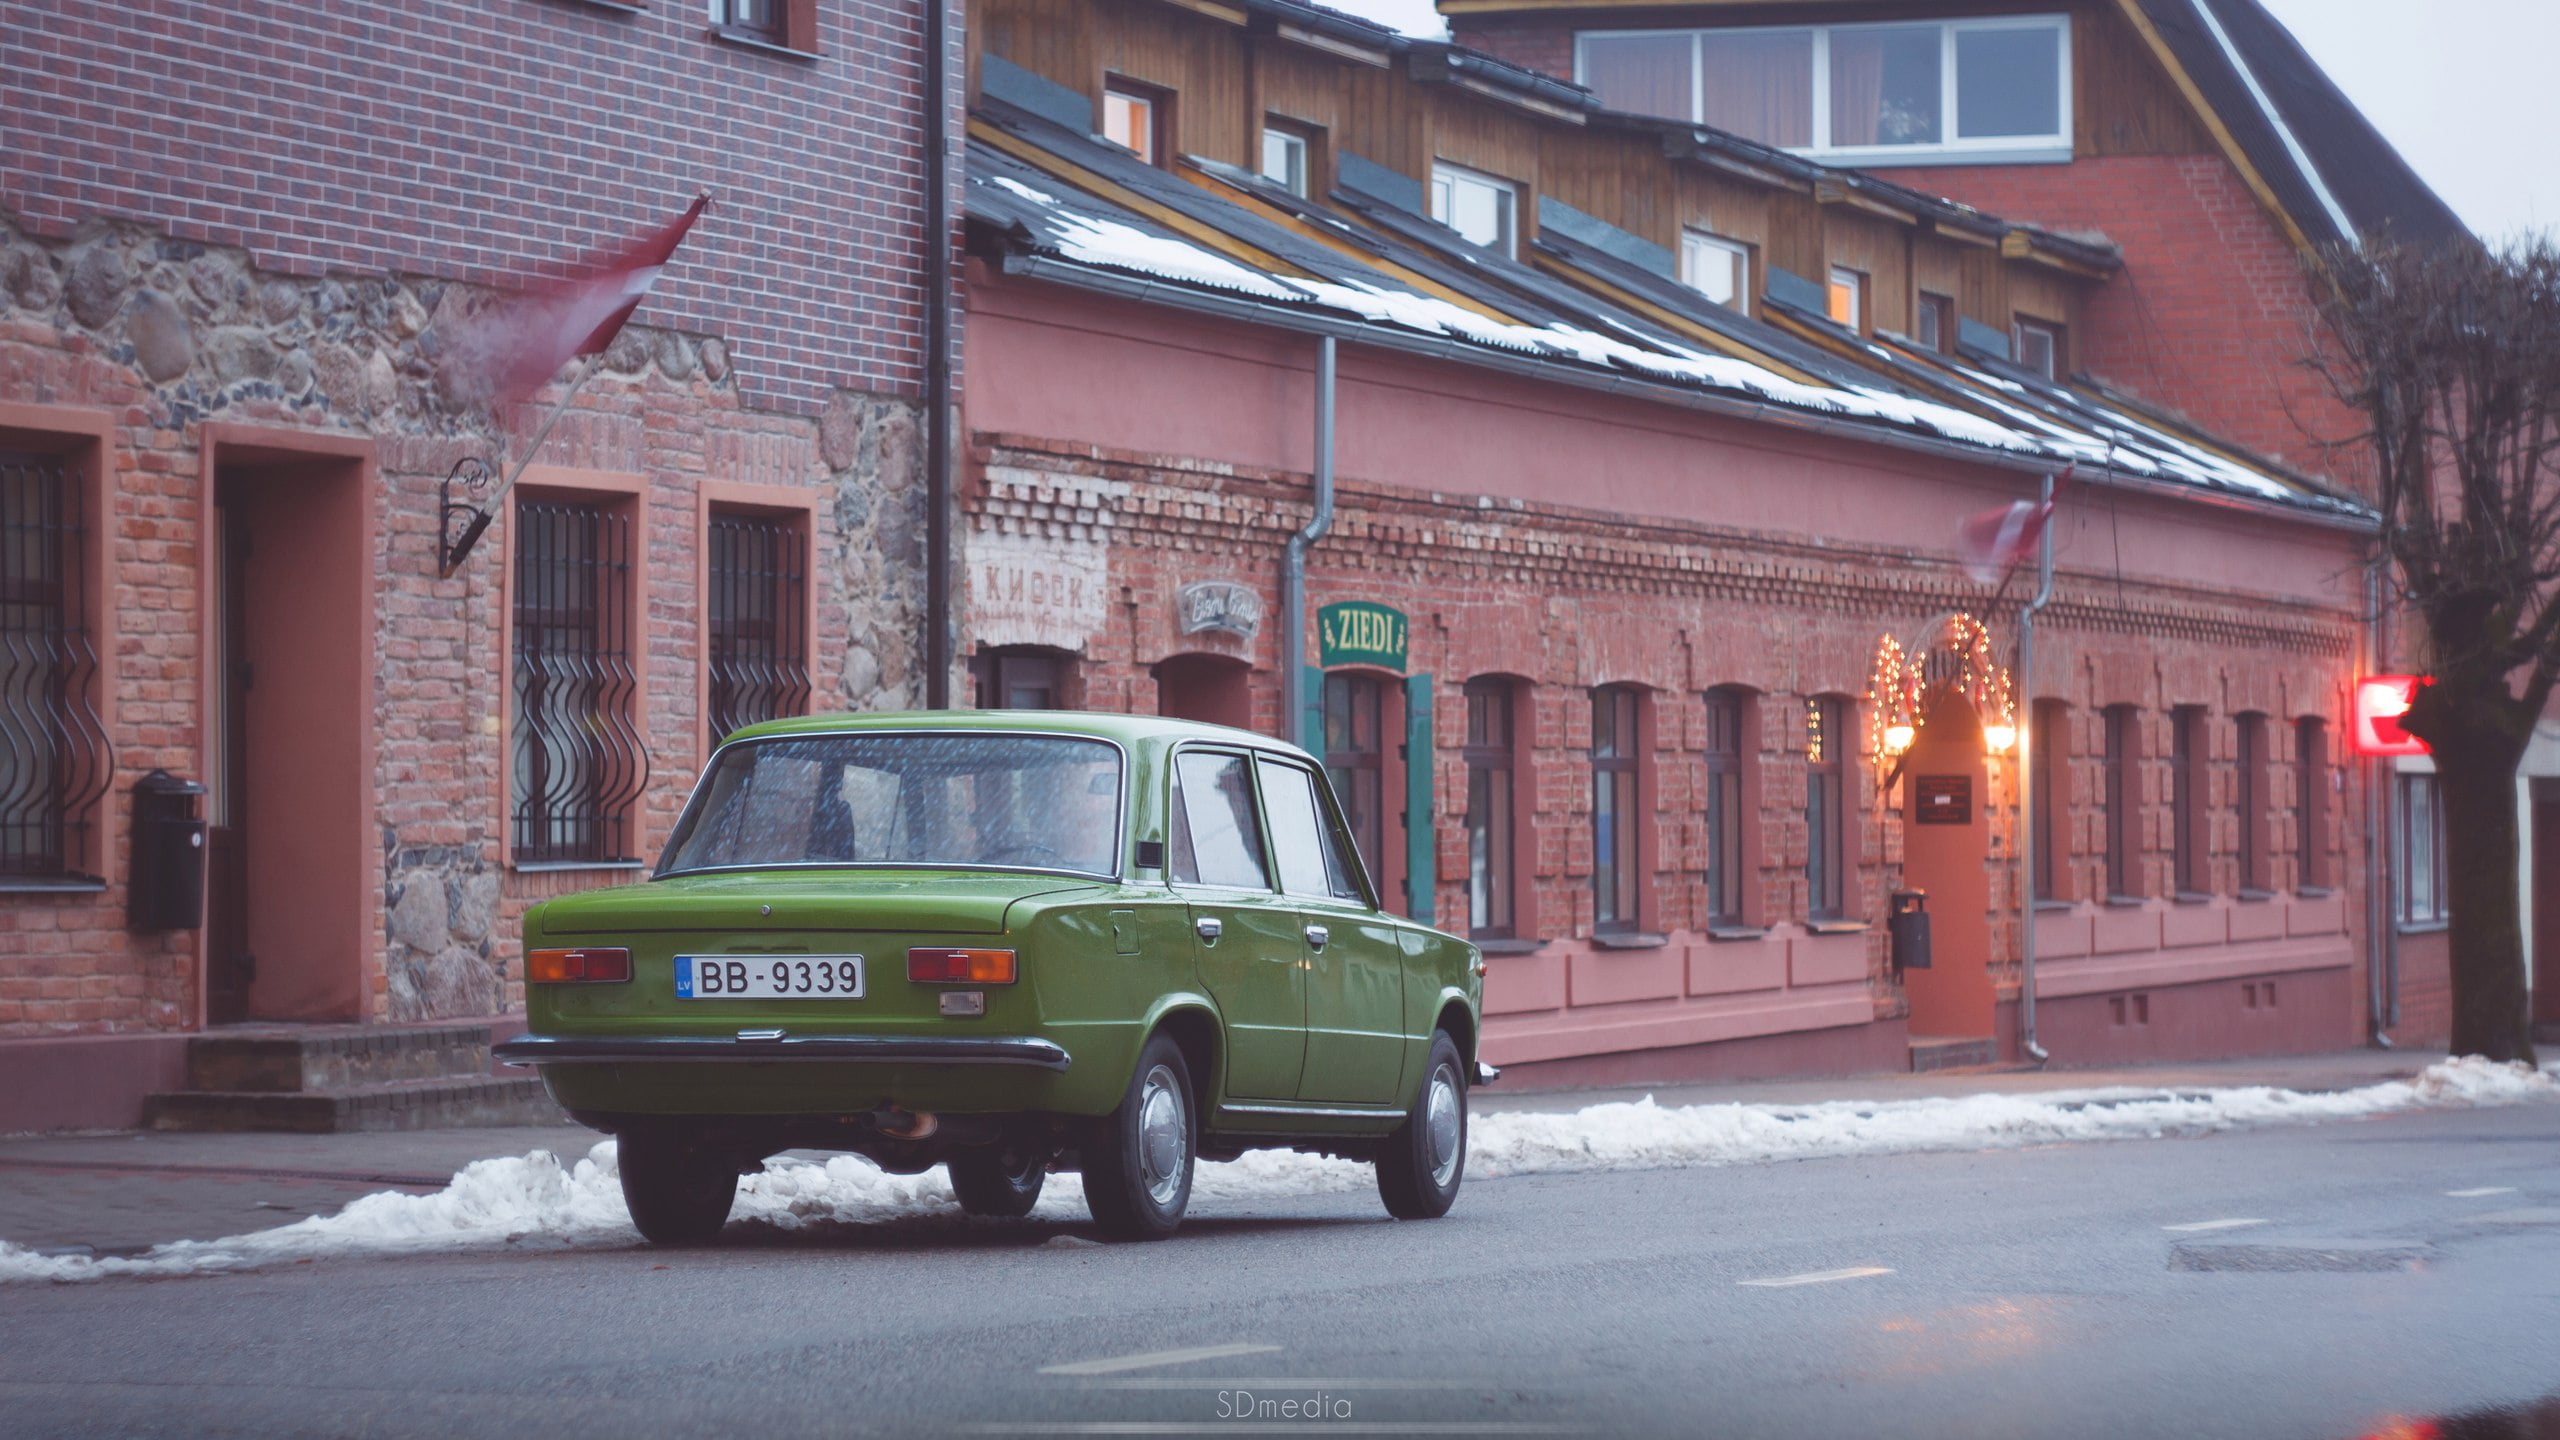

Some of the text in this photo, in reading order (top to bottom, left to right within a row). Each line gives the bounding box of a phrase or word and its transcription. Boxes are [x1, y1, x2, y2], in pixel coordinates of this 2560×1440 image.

[986, 565, 1083, 609] КИОСК
[1338, 609, 1393, 655] ZIEDI
[677, 981, 692, 991] LV
[701, 961, 857, 993] BB-9339
